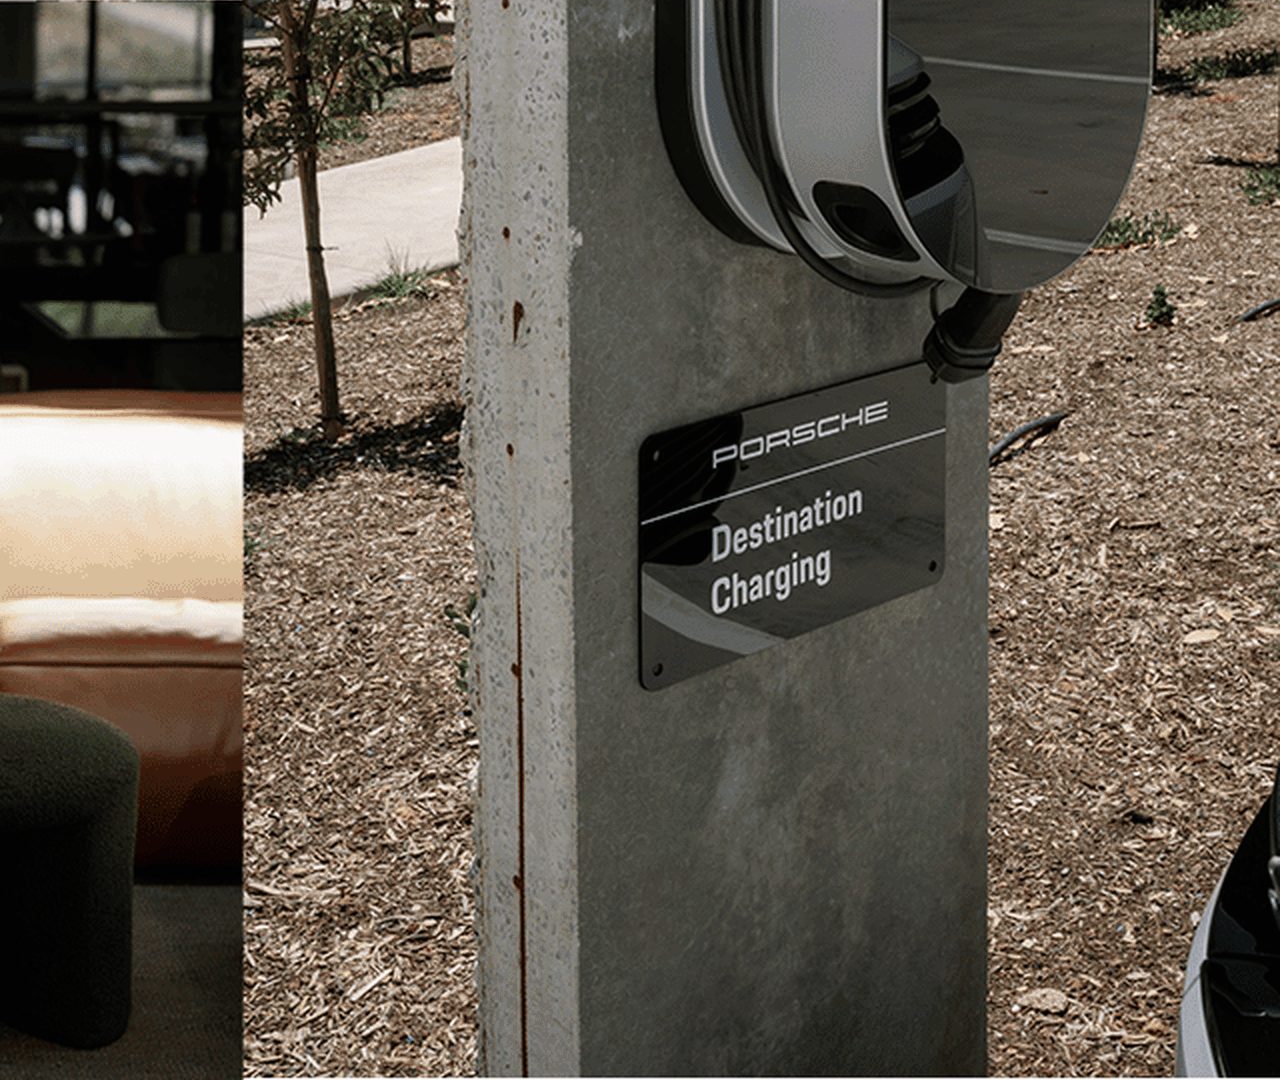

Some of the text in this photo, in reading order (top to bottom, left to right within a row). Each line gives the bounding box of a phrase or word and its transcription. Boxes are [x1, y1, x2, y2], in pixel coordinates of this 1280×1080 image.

[712, 401, 889, 469] PORSCHE
[711, 489, 863, 563] Destination
[711, 549, 831, 615] Charging
